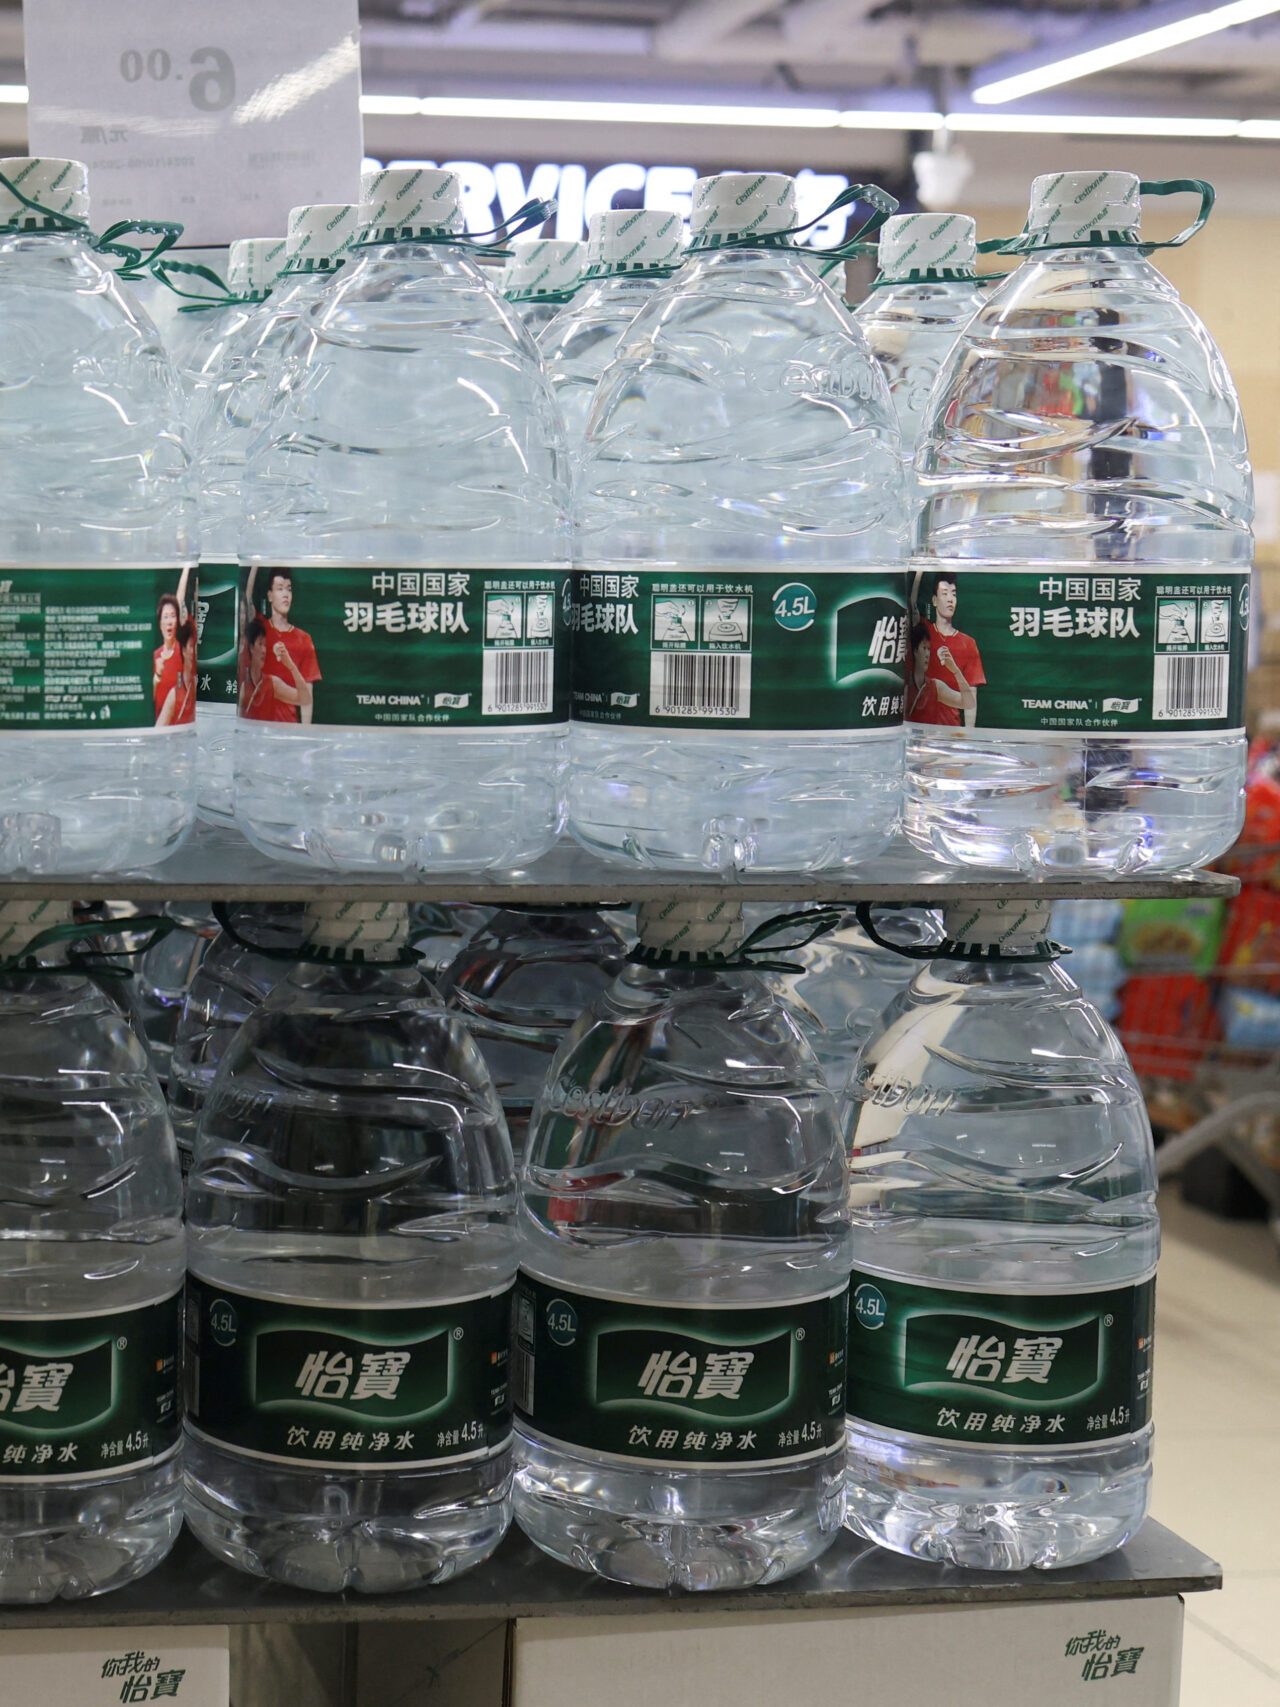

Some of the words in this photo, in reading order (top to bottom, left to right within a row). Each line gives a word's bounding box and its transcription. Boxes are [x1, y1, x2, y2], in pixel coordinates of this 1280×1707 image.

[372, 572, 470, 597] 中国国家
[580, 574, 639, 598] 中国国家
[1038, 577, 1142, 601] 中国国家
[343, 601, 469, 634] 羽毛球队
[571, 602, 639, 635] 羽毛球队
[774, 596, 815, 617] 4.5L
[1009, 607, 1141, 639] 羽毛球队
[356, 695, 386, 705] TEAM
[388, 695, 421, 705] CHINA
[666, 706, 698, 714] 901285
[703, 707, 737, 715] 991530
[1021, 699, 1052, 710] TEAM
[1054, 699, 1089, 710] CHINA
[855, 1298, 885, 1317] 4.5L
[210, 1312, 237, 1333] 4.5L
[547, 1313, 577, 1332] 4.5L
[945, 1335, 1063, 1384] 怡寶
[295, 1350, 412, 1400] 怡寶
[637, 1350, 755, 1400] 怡寶
[936, 1407, 1066, 1433] 饮用纯净水
[287, 1426, 416, 1451] 饮用纯净水
[628, 1425, 757, 1450] 饮用纯净水
[1081, 1647, 1145, 1681] 怡寶
[120, 1669, 186, 1703] 怡寶
